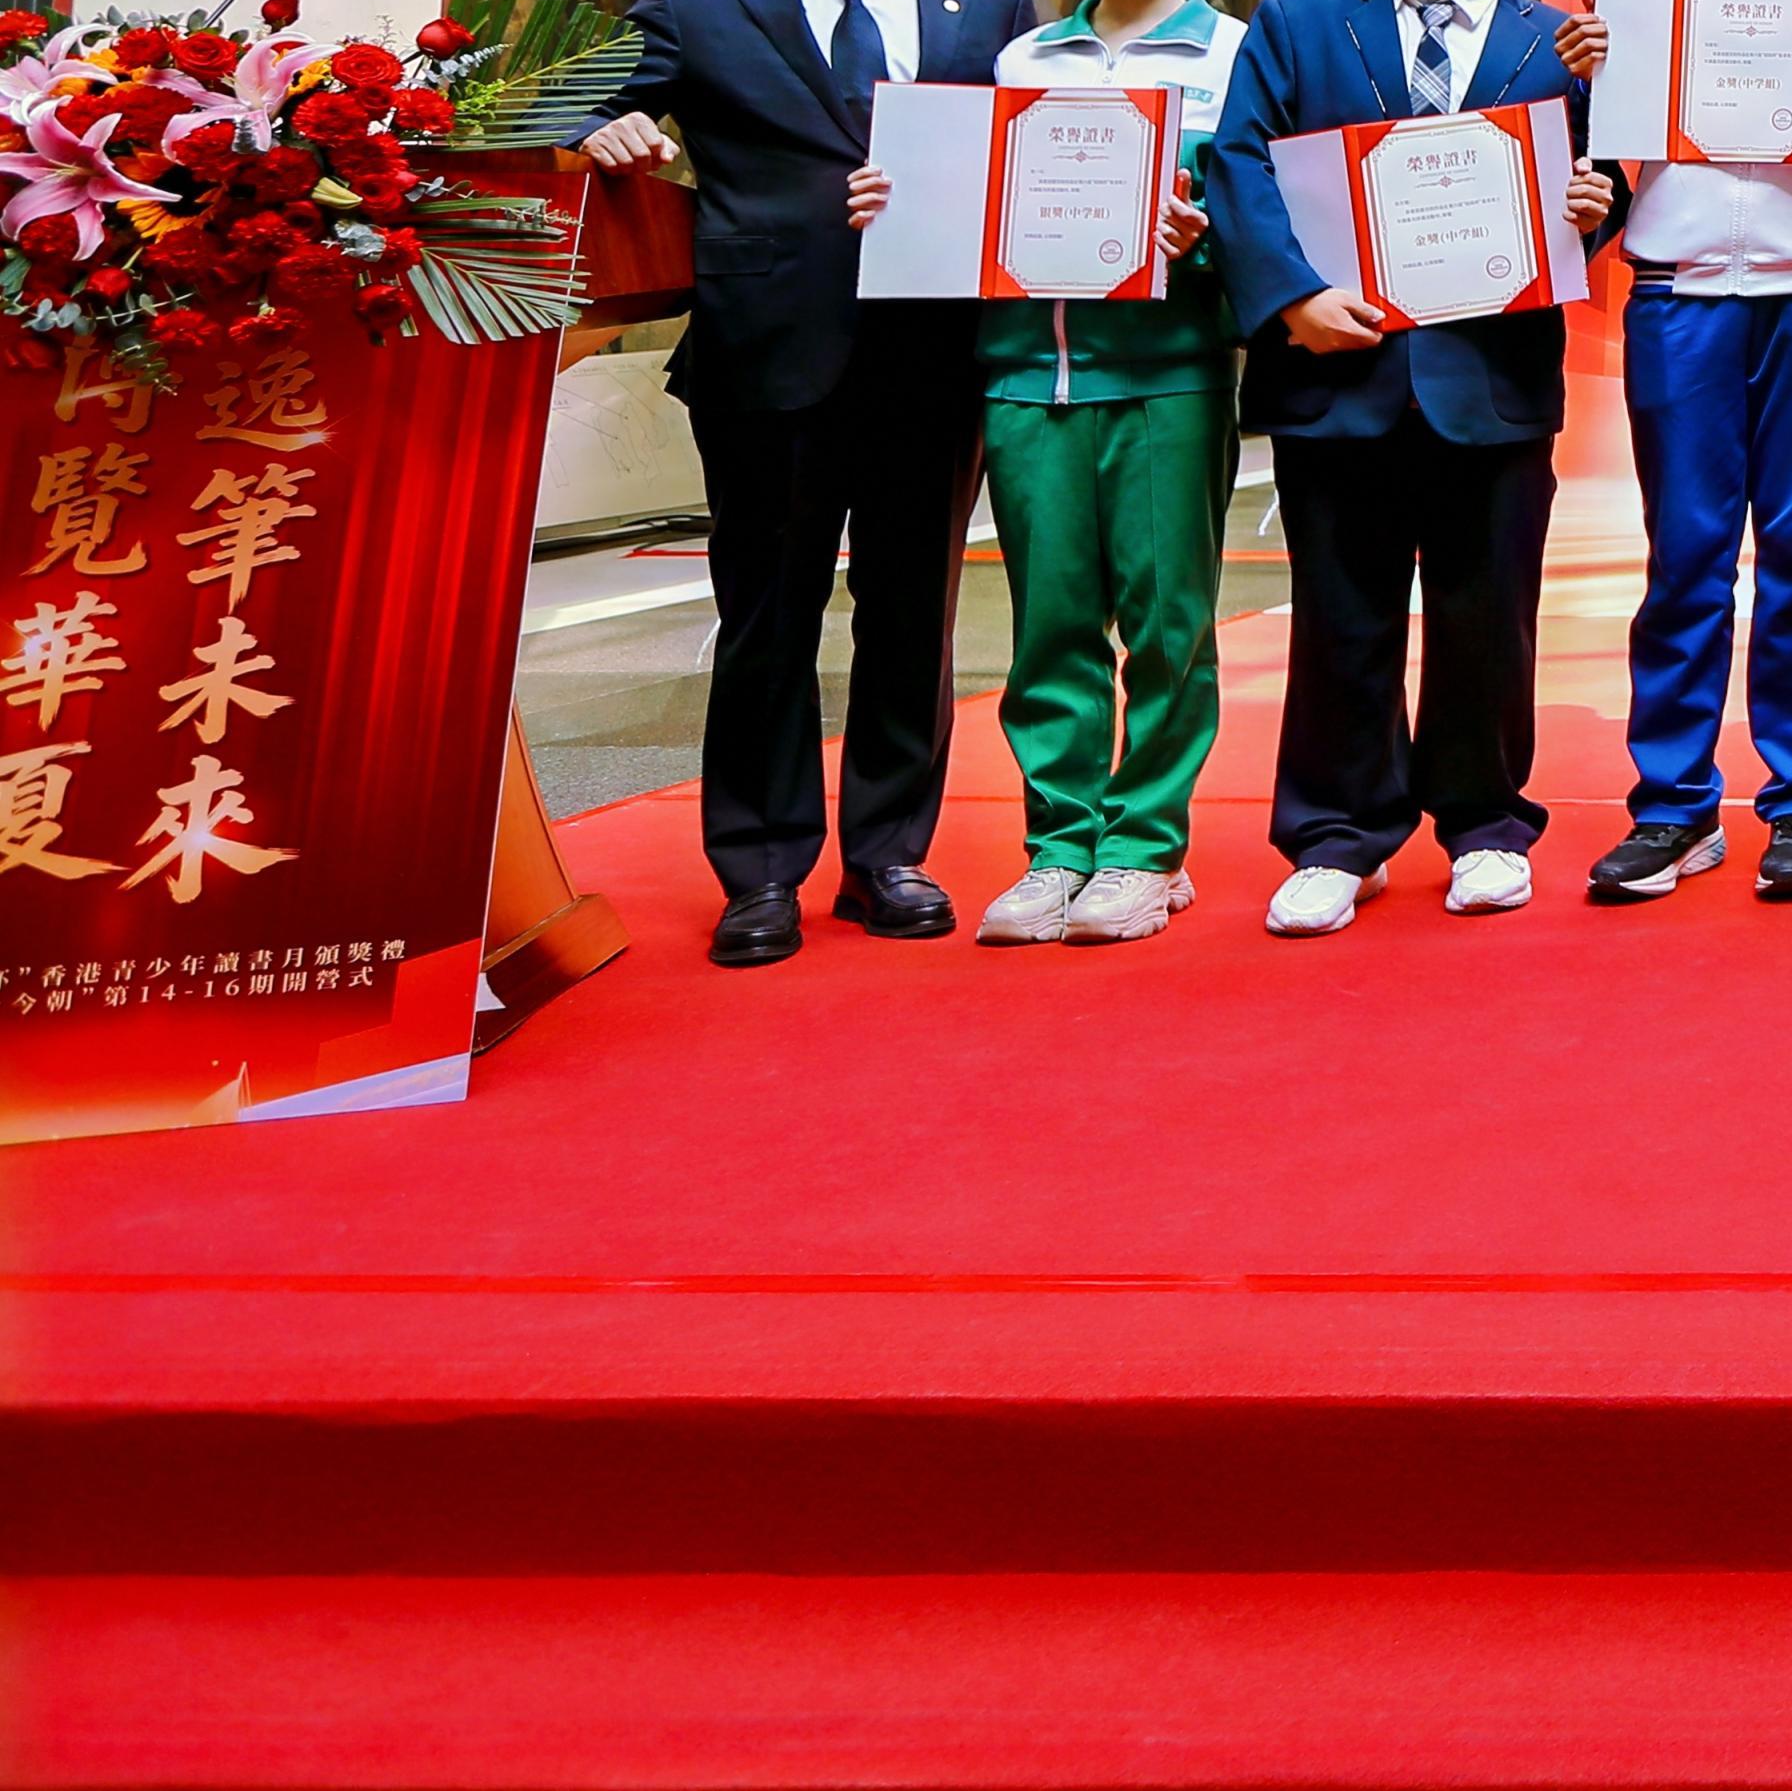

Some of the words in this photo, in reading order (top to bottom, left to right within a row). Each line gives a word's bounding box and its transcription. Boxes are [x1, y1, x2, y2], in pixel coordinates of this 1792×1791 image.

[1720, 3, 1783, 20] 榮譽證書
[1048, 126, 1116, 143] 榮譽證書
[1406, 149, 1479, 173] 榮譽證書
[117, 346, 329, 904] 逸筆未來
